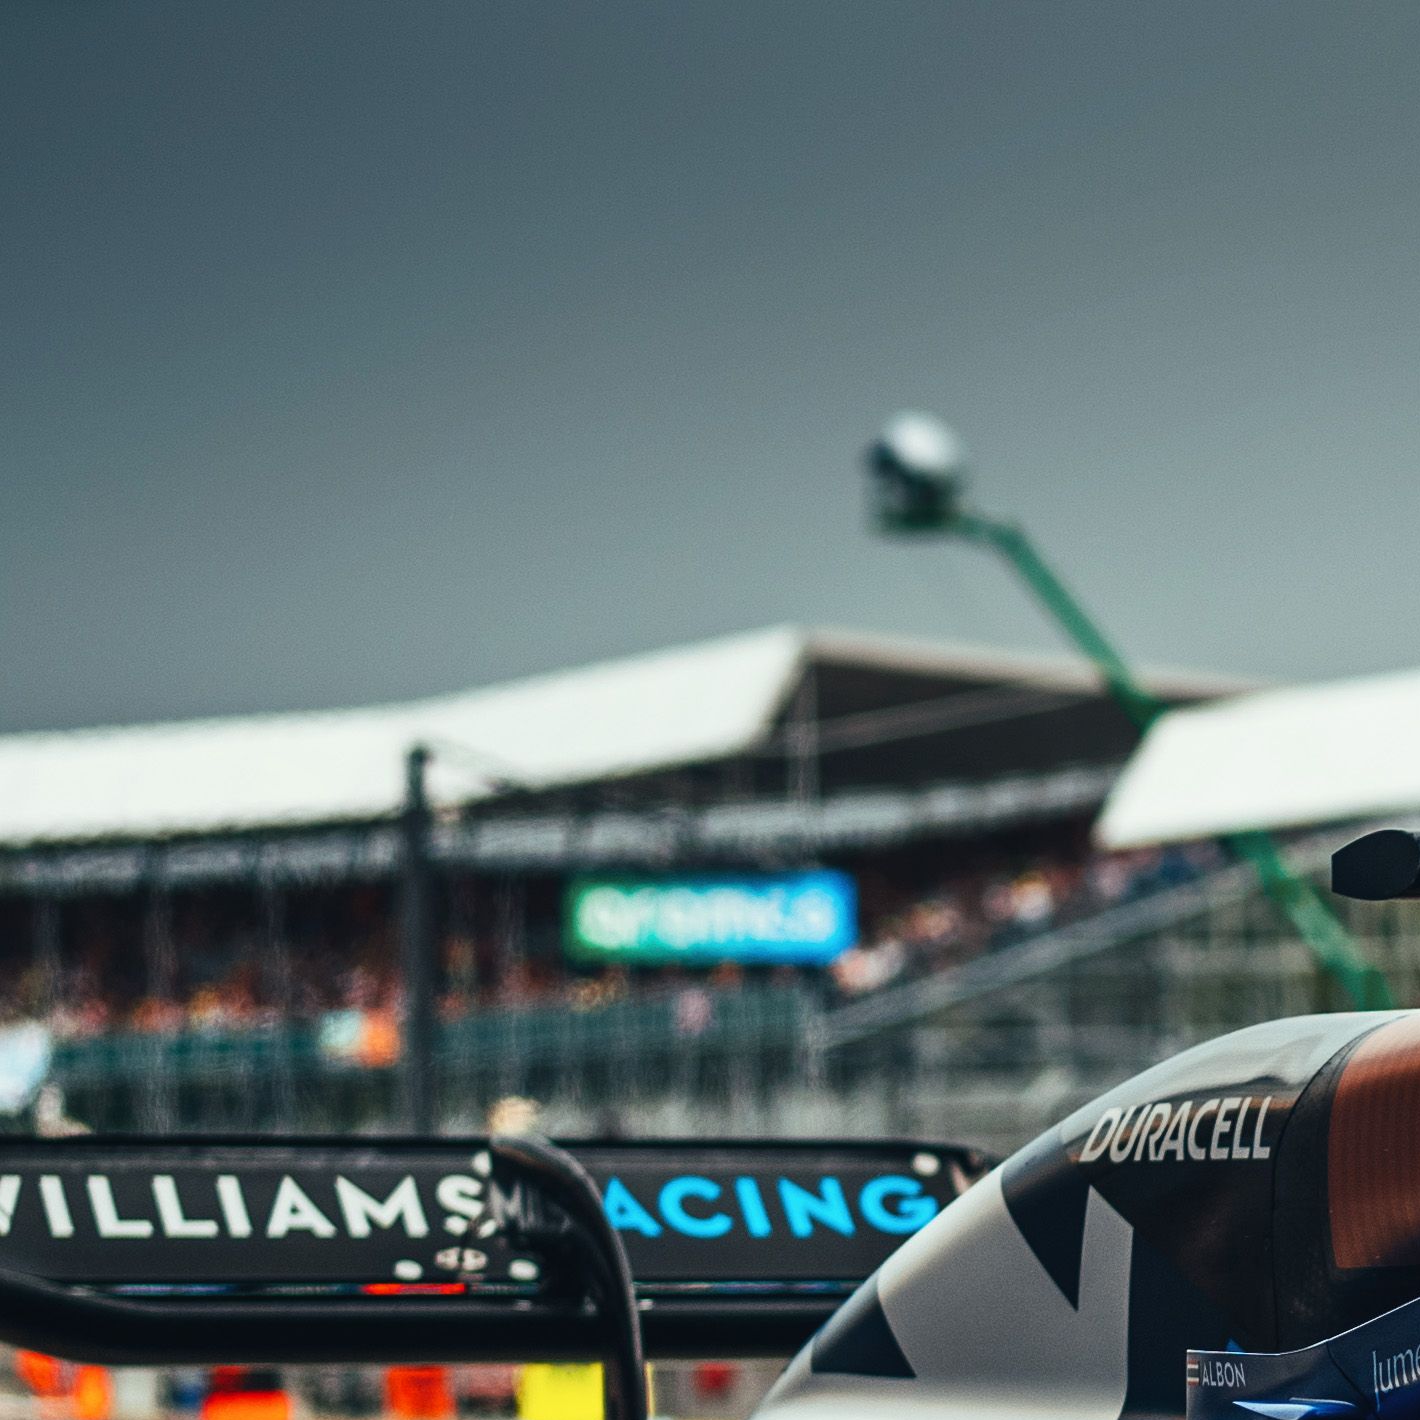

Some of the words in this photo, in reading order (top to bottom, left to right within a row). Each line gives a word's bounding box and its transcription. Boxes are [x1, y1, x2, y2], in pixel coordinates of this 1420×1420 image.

[1078, 1095, 1272, 1164] DURACELL
[0, 1173, 498, 1241] ILLIAMS
[604, 1175, 938, 1239] ACING
[1202, 1360, 1247, 1388] ALBON
